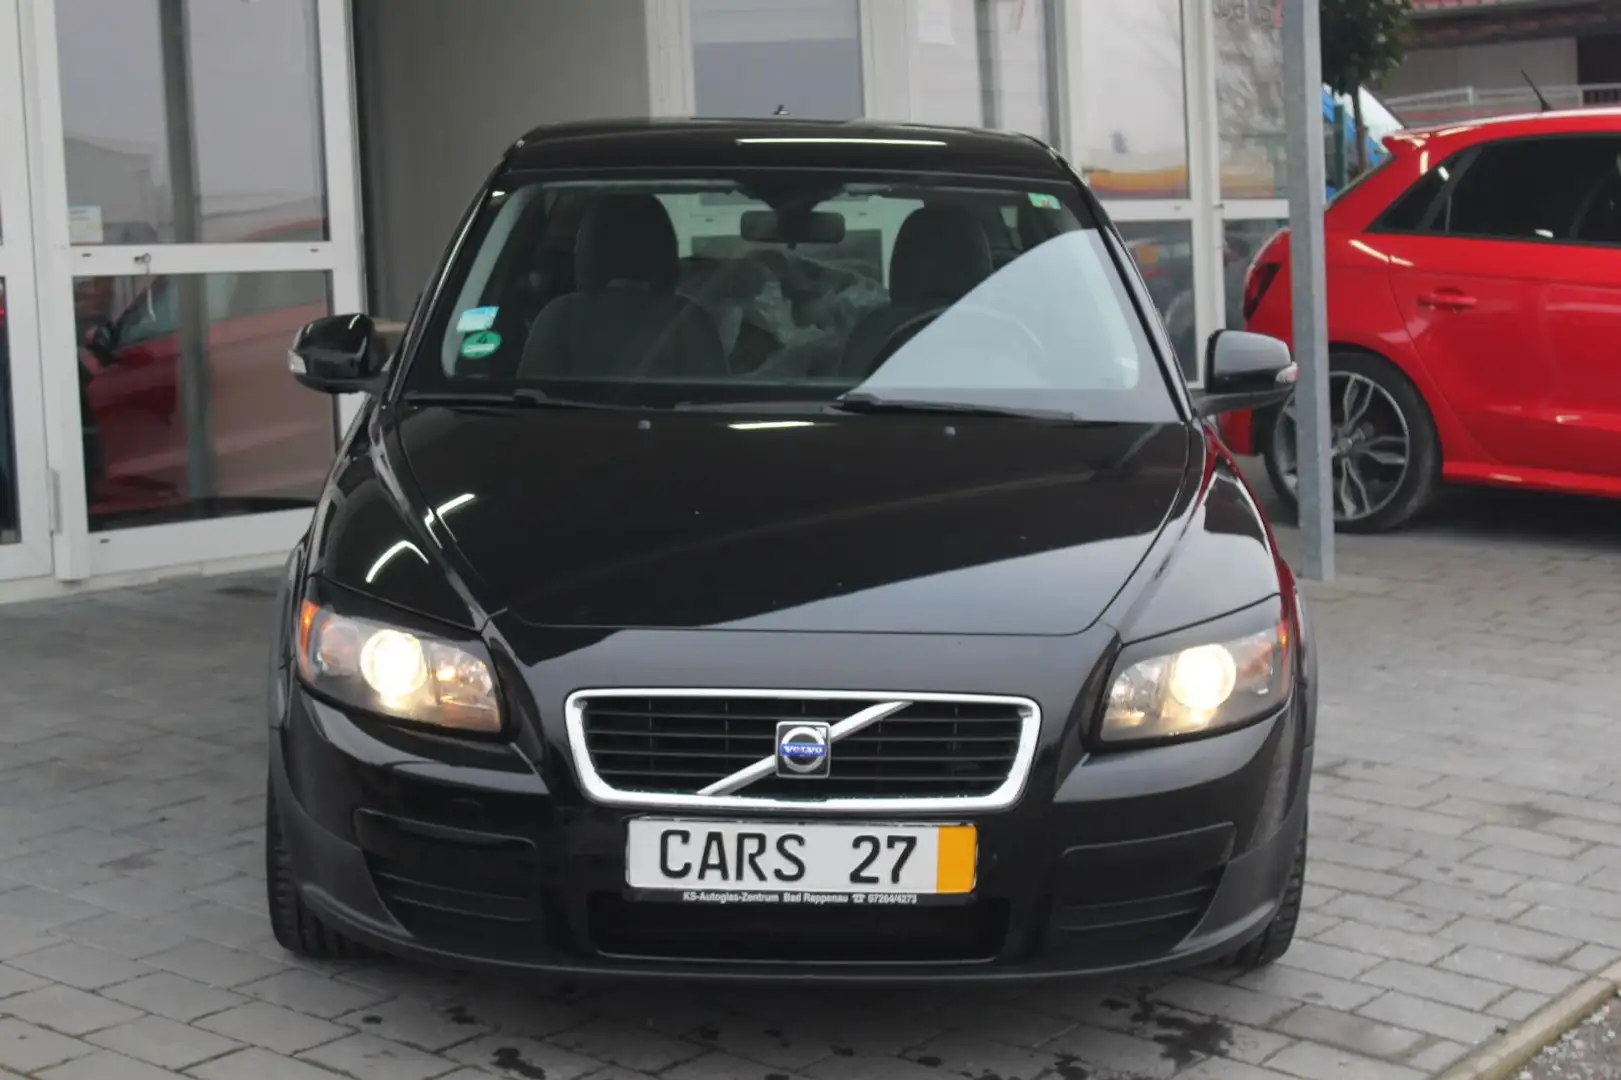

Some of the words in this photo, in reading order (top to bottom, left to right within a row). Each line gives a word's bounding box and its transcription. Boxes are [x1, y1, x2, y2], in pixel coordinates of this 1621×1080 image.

[783, 746, 823, 754] VOLVO
[659, 828, 807, 882] CARS
[849, 834, 918, 885] 27
[683, 891, 779, 904] KS-Autoglas-Zentrum
[783, 892, 801, 903] Bad
[803, 892, 849, 904] Rappenau
